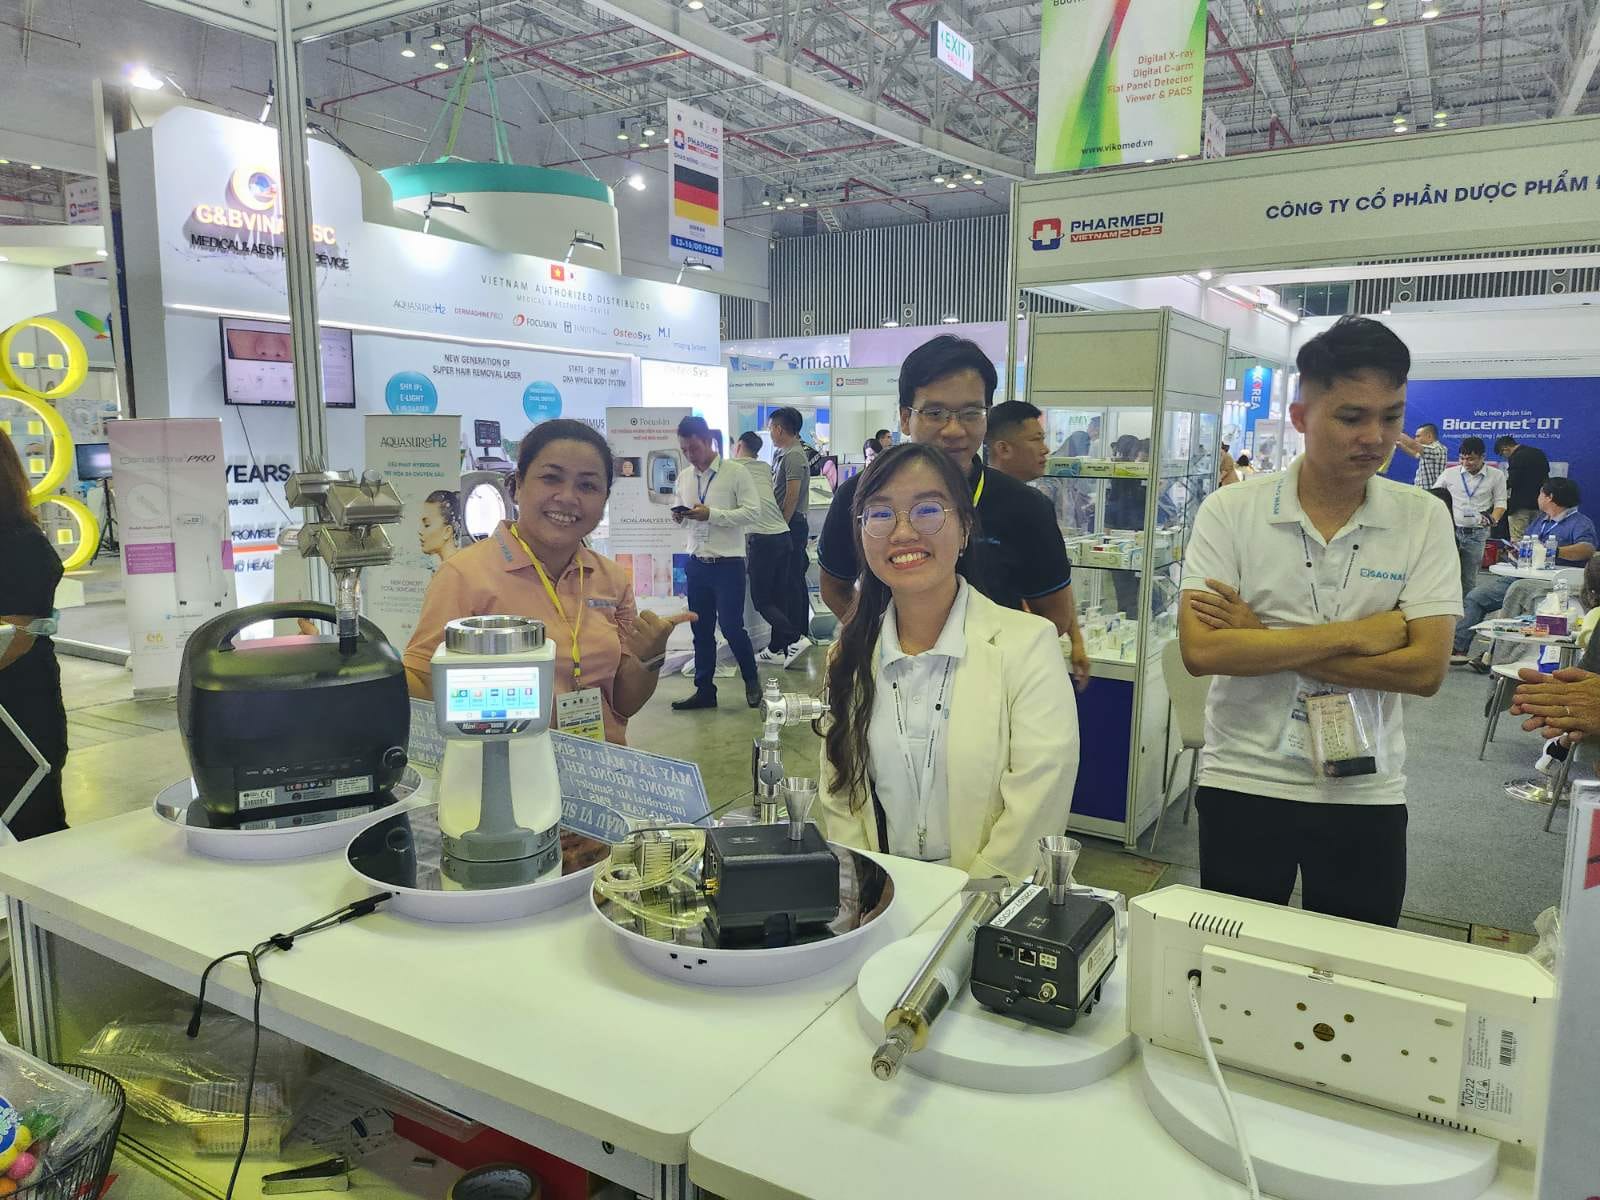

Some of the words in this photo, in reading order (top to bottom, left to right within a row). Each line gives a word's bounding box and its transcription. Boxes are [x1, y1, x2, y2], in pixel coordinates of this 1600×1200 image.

[945, 32, 966, 59] EXIT
[1138, 53, 1166, 65] Digital
[1169, 48, 1194, 59] X-ray
[1133, 67, 1162, 78] Digital
[1164, 62, 1194, 73] C-arm
[1107, 84, 1124, 94] Flat
[1126, 80, 1152, 91] Panel
[1154, 75, 1193, 87] Detector
[1126, 94, 1155, 104] Viewer
[1159, 90, 1166, 99] &
[1168, 86, 1193, 97] PACS
[1081, 139, 1153, 155] www.vikomed.vn
[1266, 201, 1323, 219] CÔNG
[1329, 198, 1350, 213] TY
[1356, 186, 1386, 211] CỔ
[1455, 180, 1517, 203] DƯỢC
[1525, 169, 1588, 195] PHẨM
[1071, 212, 1164, 232] PHARMEDI
[1071, 231, 1118, 242] VIETNAM
[1120, 225, 1162, 238] 2023
[481, 275, 528, 291] VIETNAM
[535, 284, 593, 302] AUTHORIZED
[597, 295, 650, 311] DISTRIBUTOR
[613, 327, 651, 341] OsteoSys
[444, 354, 459, 363] NEW
[462, 356, 500, 367] GENERATION
[502, 359, 511, 367] OF
[432, 365, 454, 374] SUPER
[455, 367, 471, 376] HAIR
[472, 368, 502, 378] REMOVAL
[503, 370, 522, 380] LASER
[1442, 417, 1530, 431] Biocemet
[1536, 417, 1564, 430] DT
[187, 454, 216, 464] PRO
[1463, 1078, 1475, 1105] UV222
